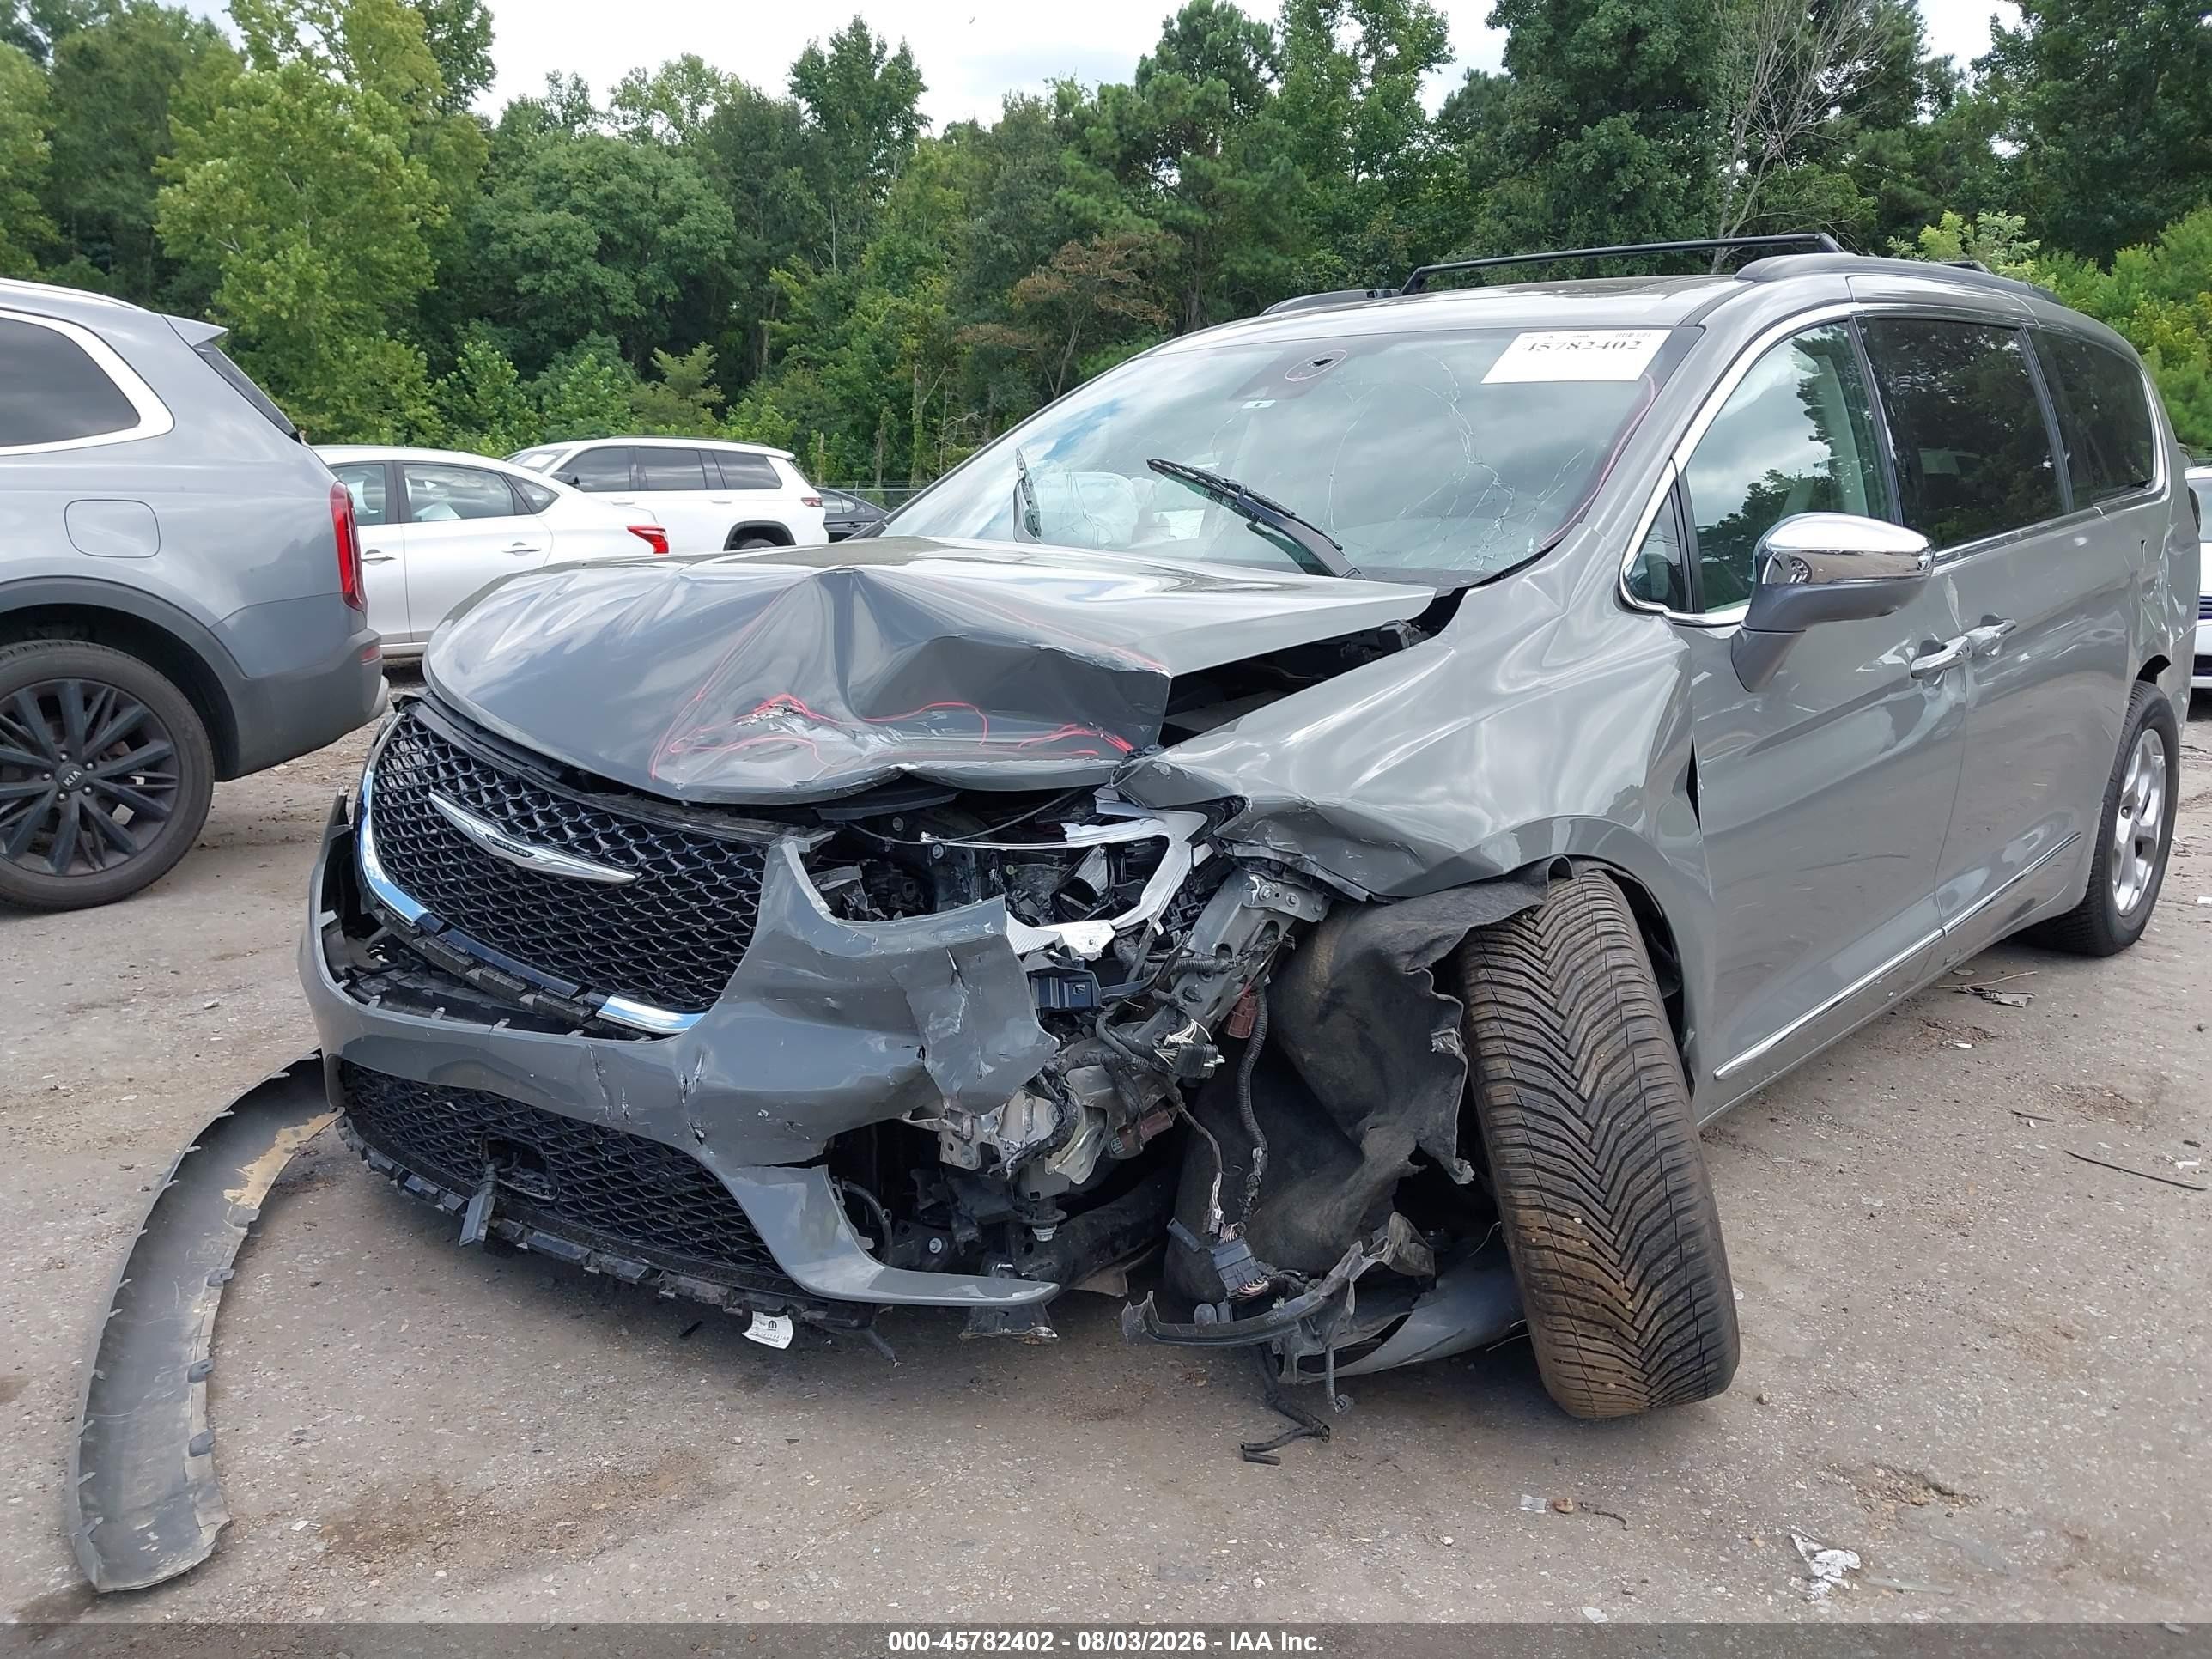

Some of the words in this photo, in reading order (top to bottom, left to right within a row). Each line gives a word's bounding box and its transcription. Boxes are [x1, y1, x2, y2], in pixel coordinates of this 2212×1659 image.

[1522, 340, 1642, 351] 45782402
[63, 770, 82, 787] KIA
[489, 837, 530, 857] CHRYSLER
